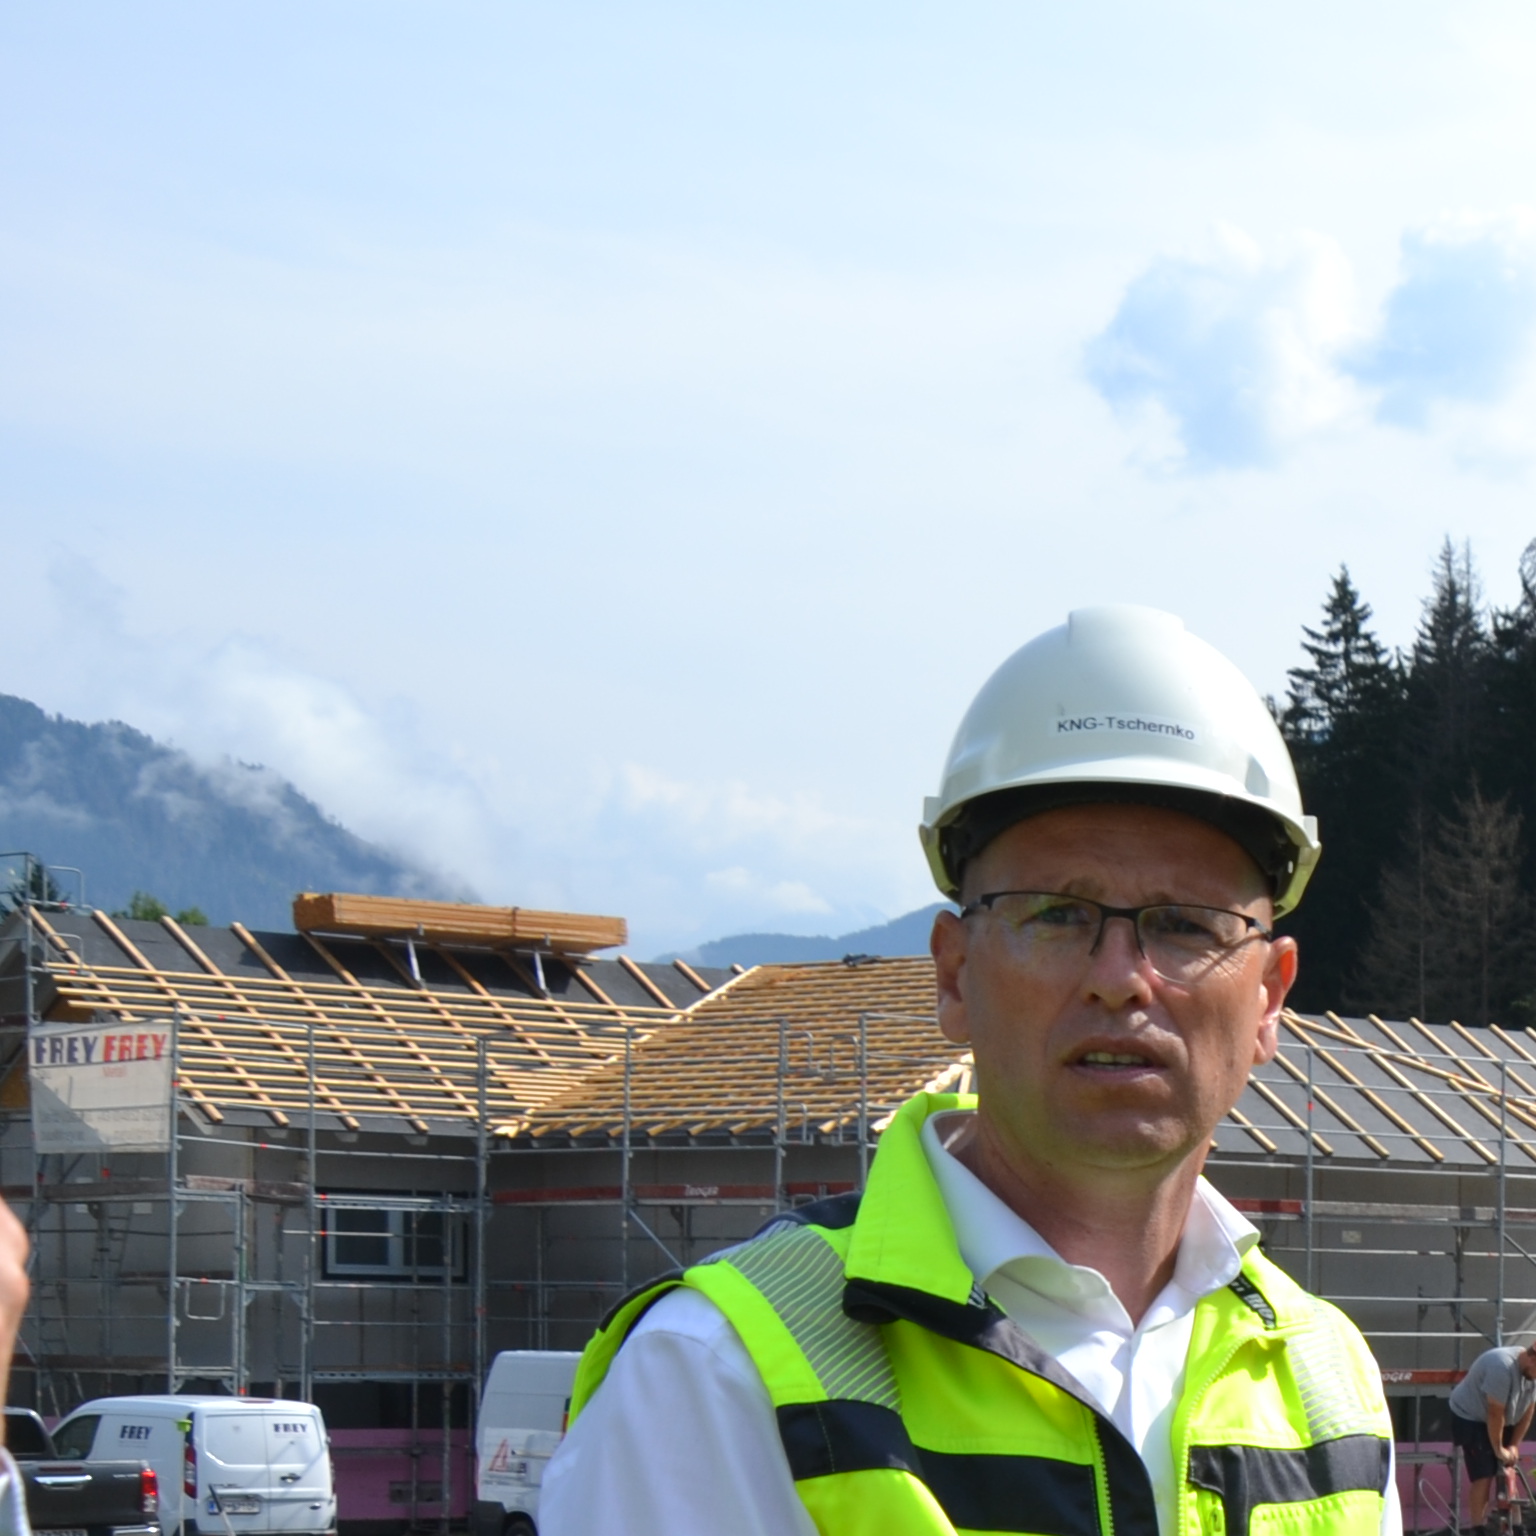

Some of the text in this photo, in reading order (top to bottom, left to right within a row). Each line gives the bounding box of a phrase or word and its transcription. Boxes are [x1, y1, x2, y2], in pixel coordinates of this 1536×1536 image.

[1056, 716, 1195, 741] KNG-Tschernko
[34, 1033, 168, 1064] FREY FREY
[119, 1424, 154, 1440] FREY
[272, 1423, 307, 1433] FREY
